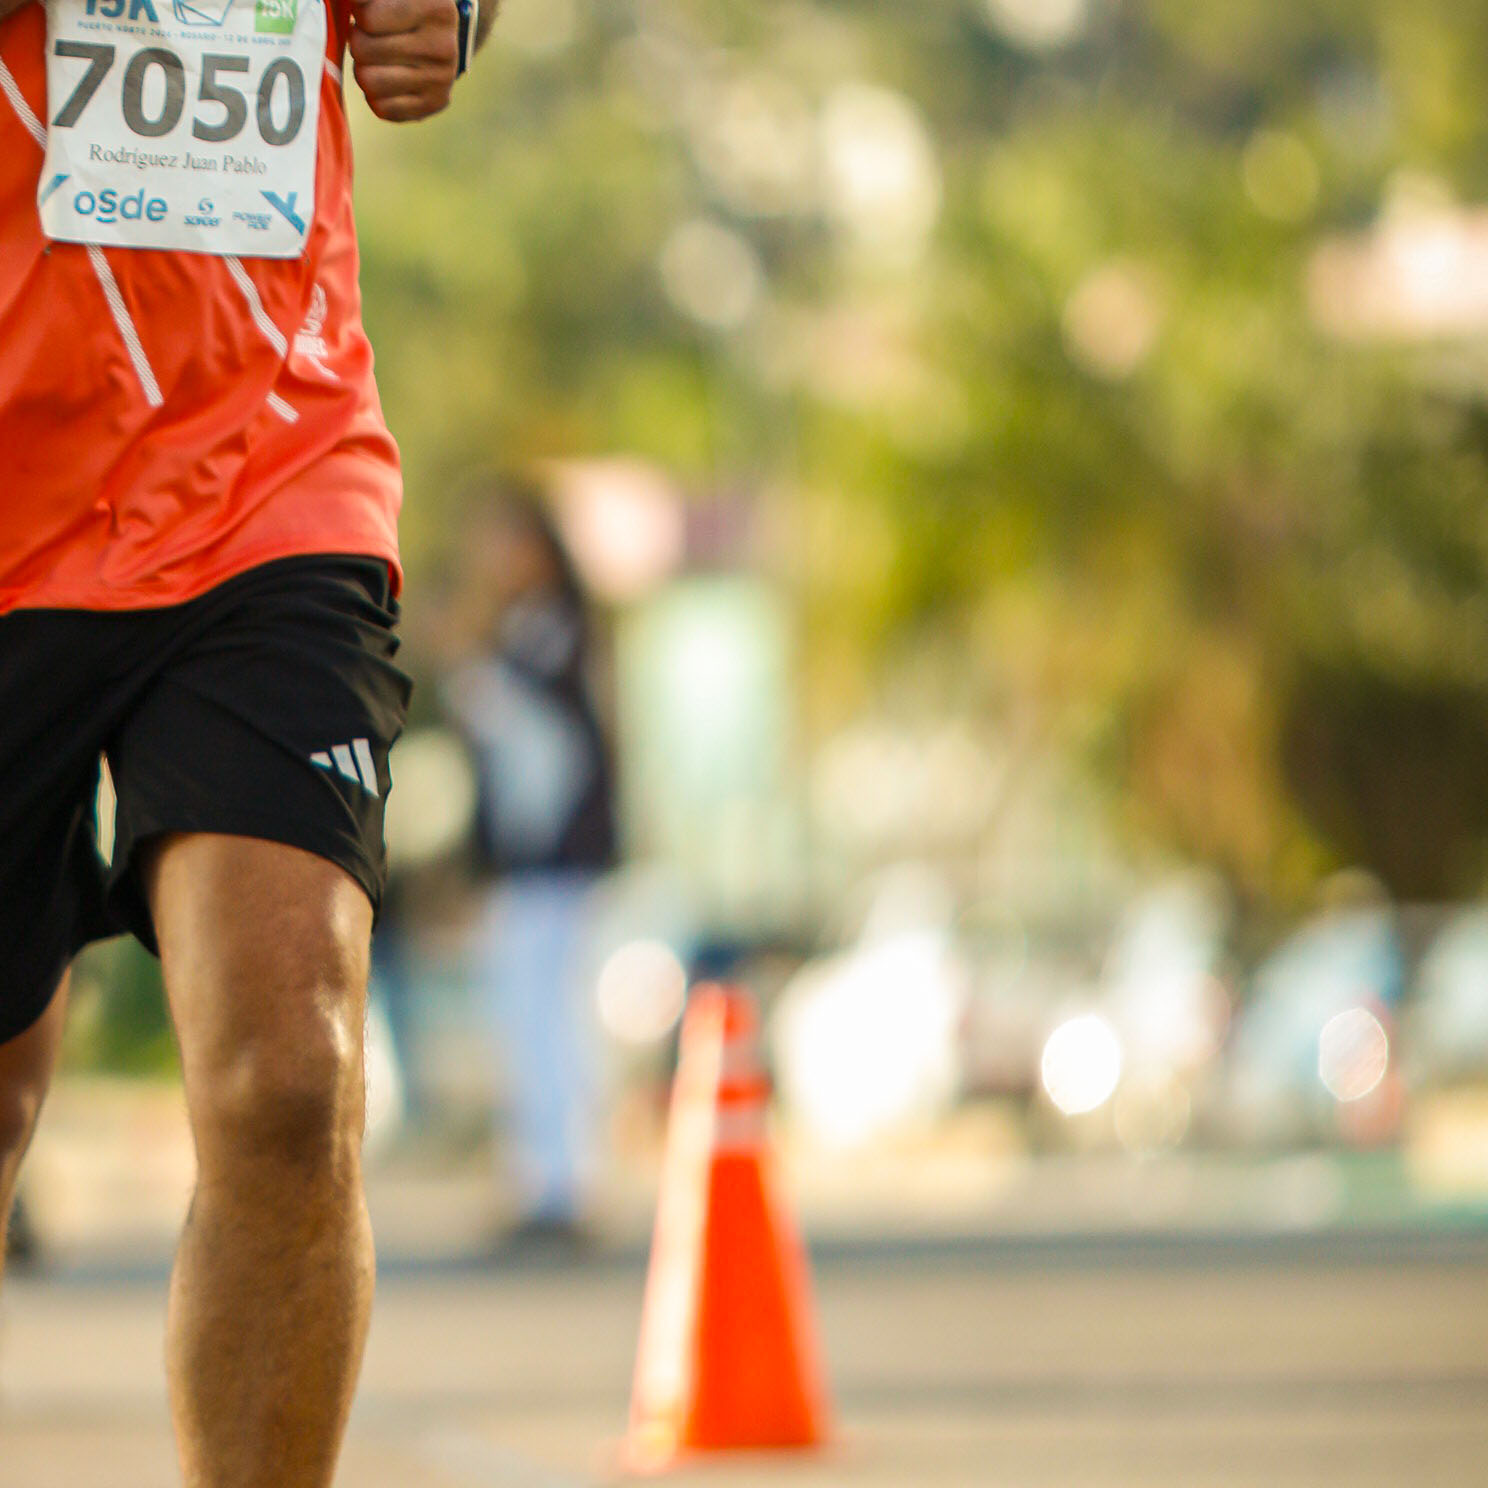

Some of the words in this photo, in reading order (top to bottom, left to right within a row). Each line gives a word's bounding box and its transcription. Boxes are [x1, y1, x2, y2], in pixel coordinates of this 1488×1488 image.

[52, 39, 306, 147] 7050
[182, 152, 218, 171] Juan
[222, 154, 267, 175] Pablo
[74, 187, 169, 223] osde
